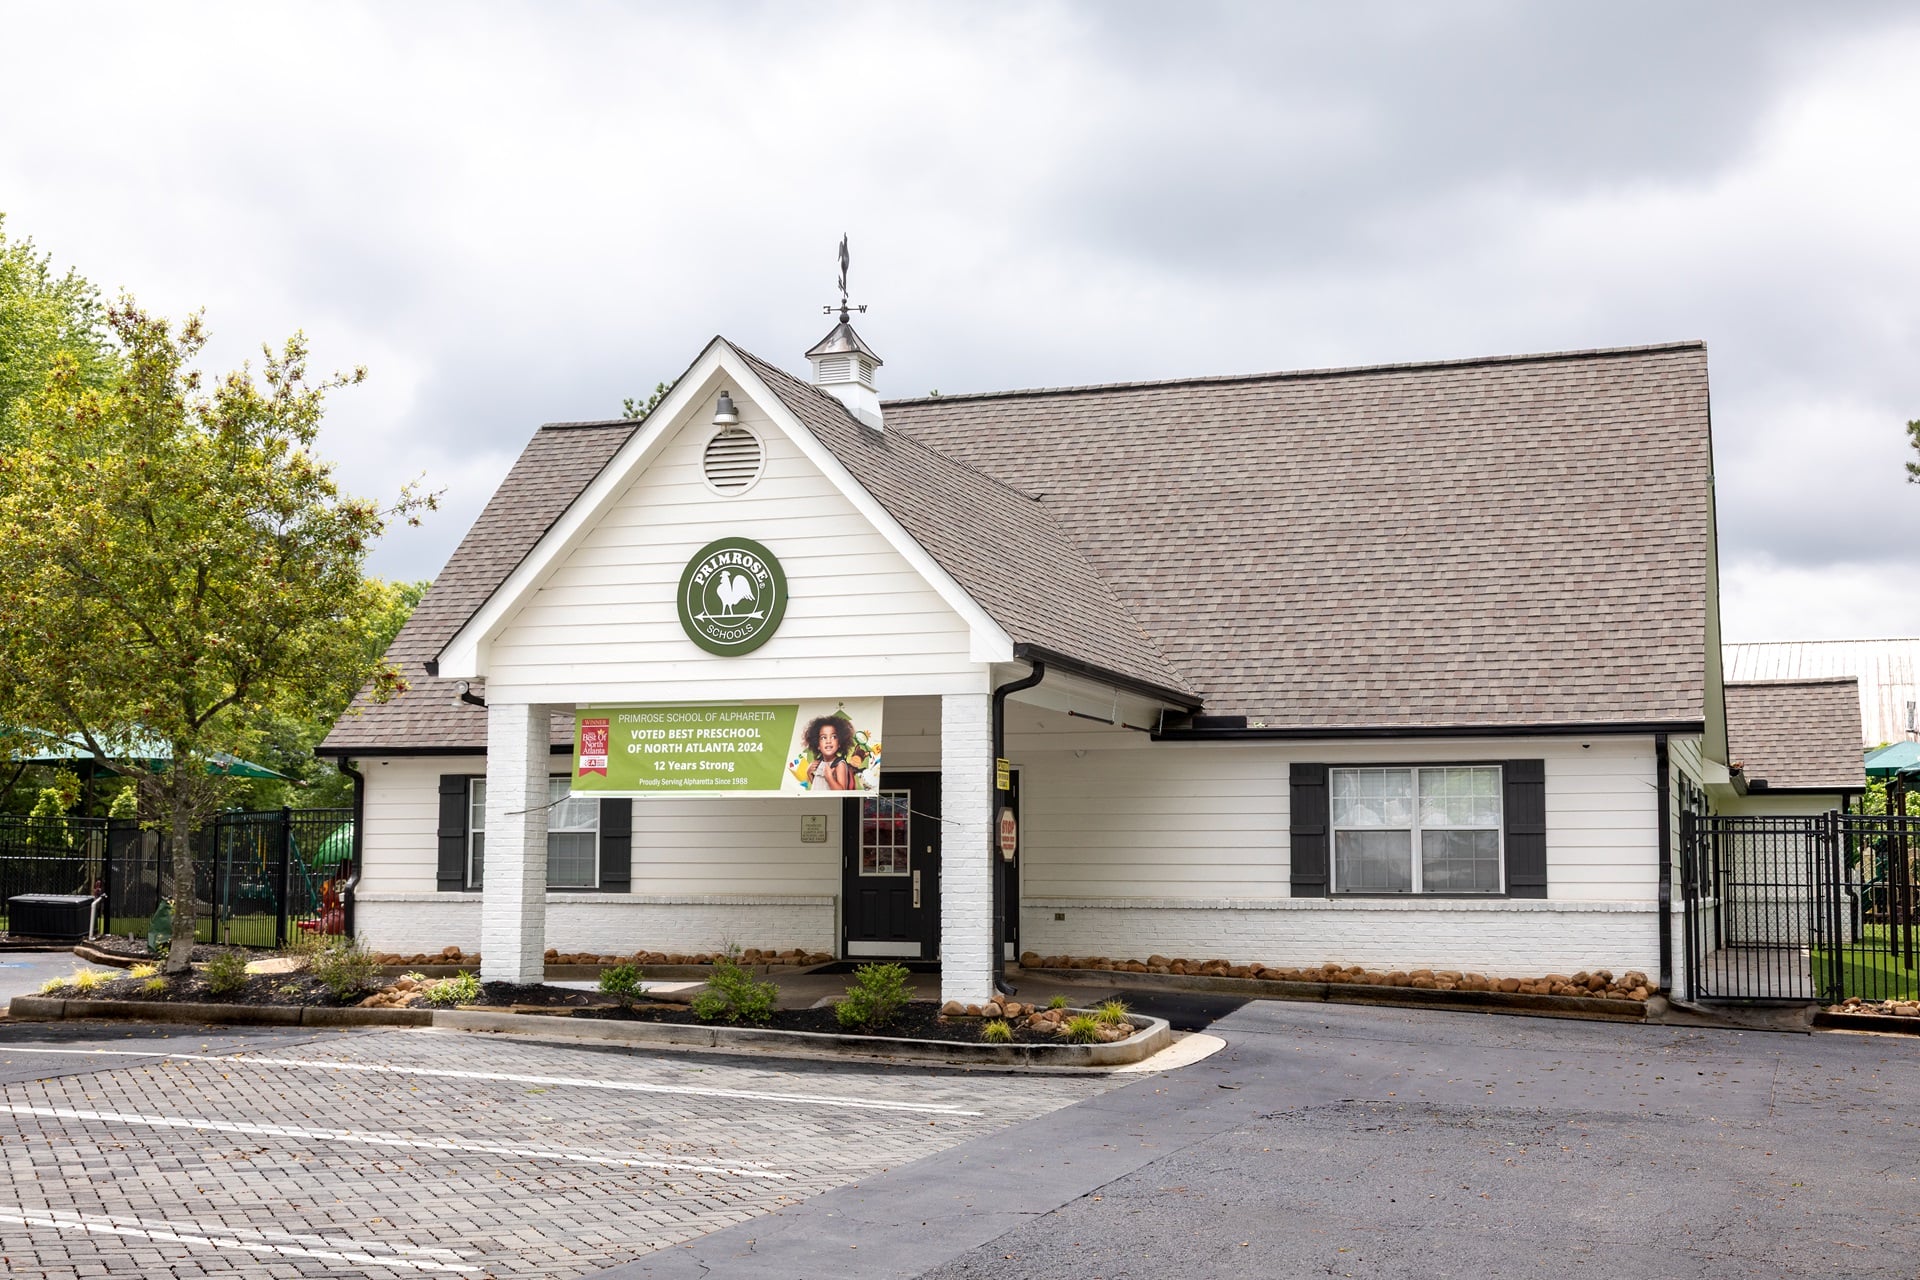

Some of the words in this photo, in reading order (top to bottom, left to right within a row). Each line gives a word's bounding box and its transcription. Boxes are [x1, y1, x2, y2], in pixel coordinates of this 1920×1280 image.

[858, 305, 867, 313] W
[694, 552, 768, 586] PRIMROSE
[706, 623, 754, 639] SCHOOLS
[618, 713, 665, 723] PRIMROSE
[666, 712, 703, 722] SCHOOL
[705, 712, 717, 722] OF
[719, 711, 776, 721] ALPHARETTA
[631, 729, 666, 740] VOTED
[668, 728, 694, 739] BEST
[696, 728, 761, 739] PRESCHOOL
[585, 740, 604, 748] North
[627, 743, 642, 754] OF
[644, 743, 683, 753] NORTH
[685, 742, 735, 753] ATLANTA
[737, 742, 764, 752] 2024
[582, 747, 606, 755] Atlanta
[653, 761, 666, 771] 12
[668, 760, 697, 771] Years
[699, 760, 735, 772] Strong
[639, 778, 660, 787] Proudly
[661, 778, 682, 787] Serving
[683, 778, 714, 786] Alpharetta
[714, 777, 731, 785] Since
[732, 777, 748, 785] 1988
[1002, 820, 1014, 834] STOP
